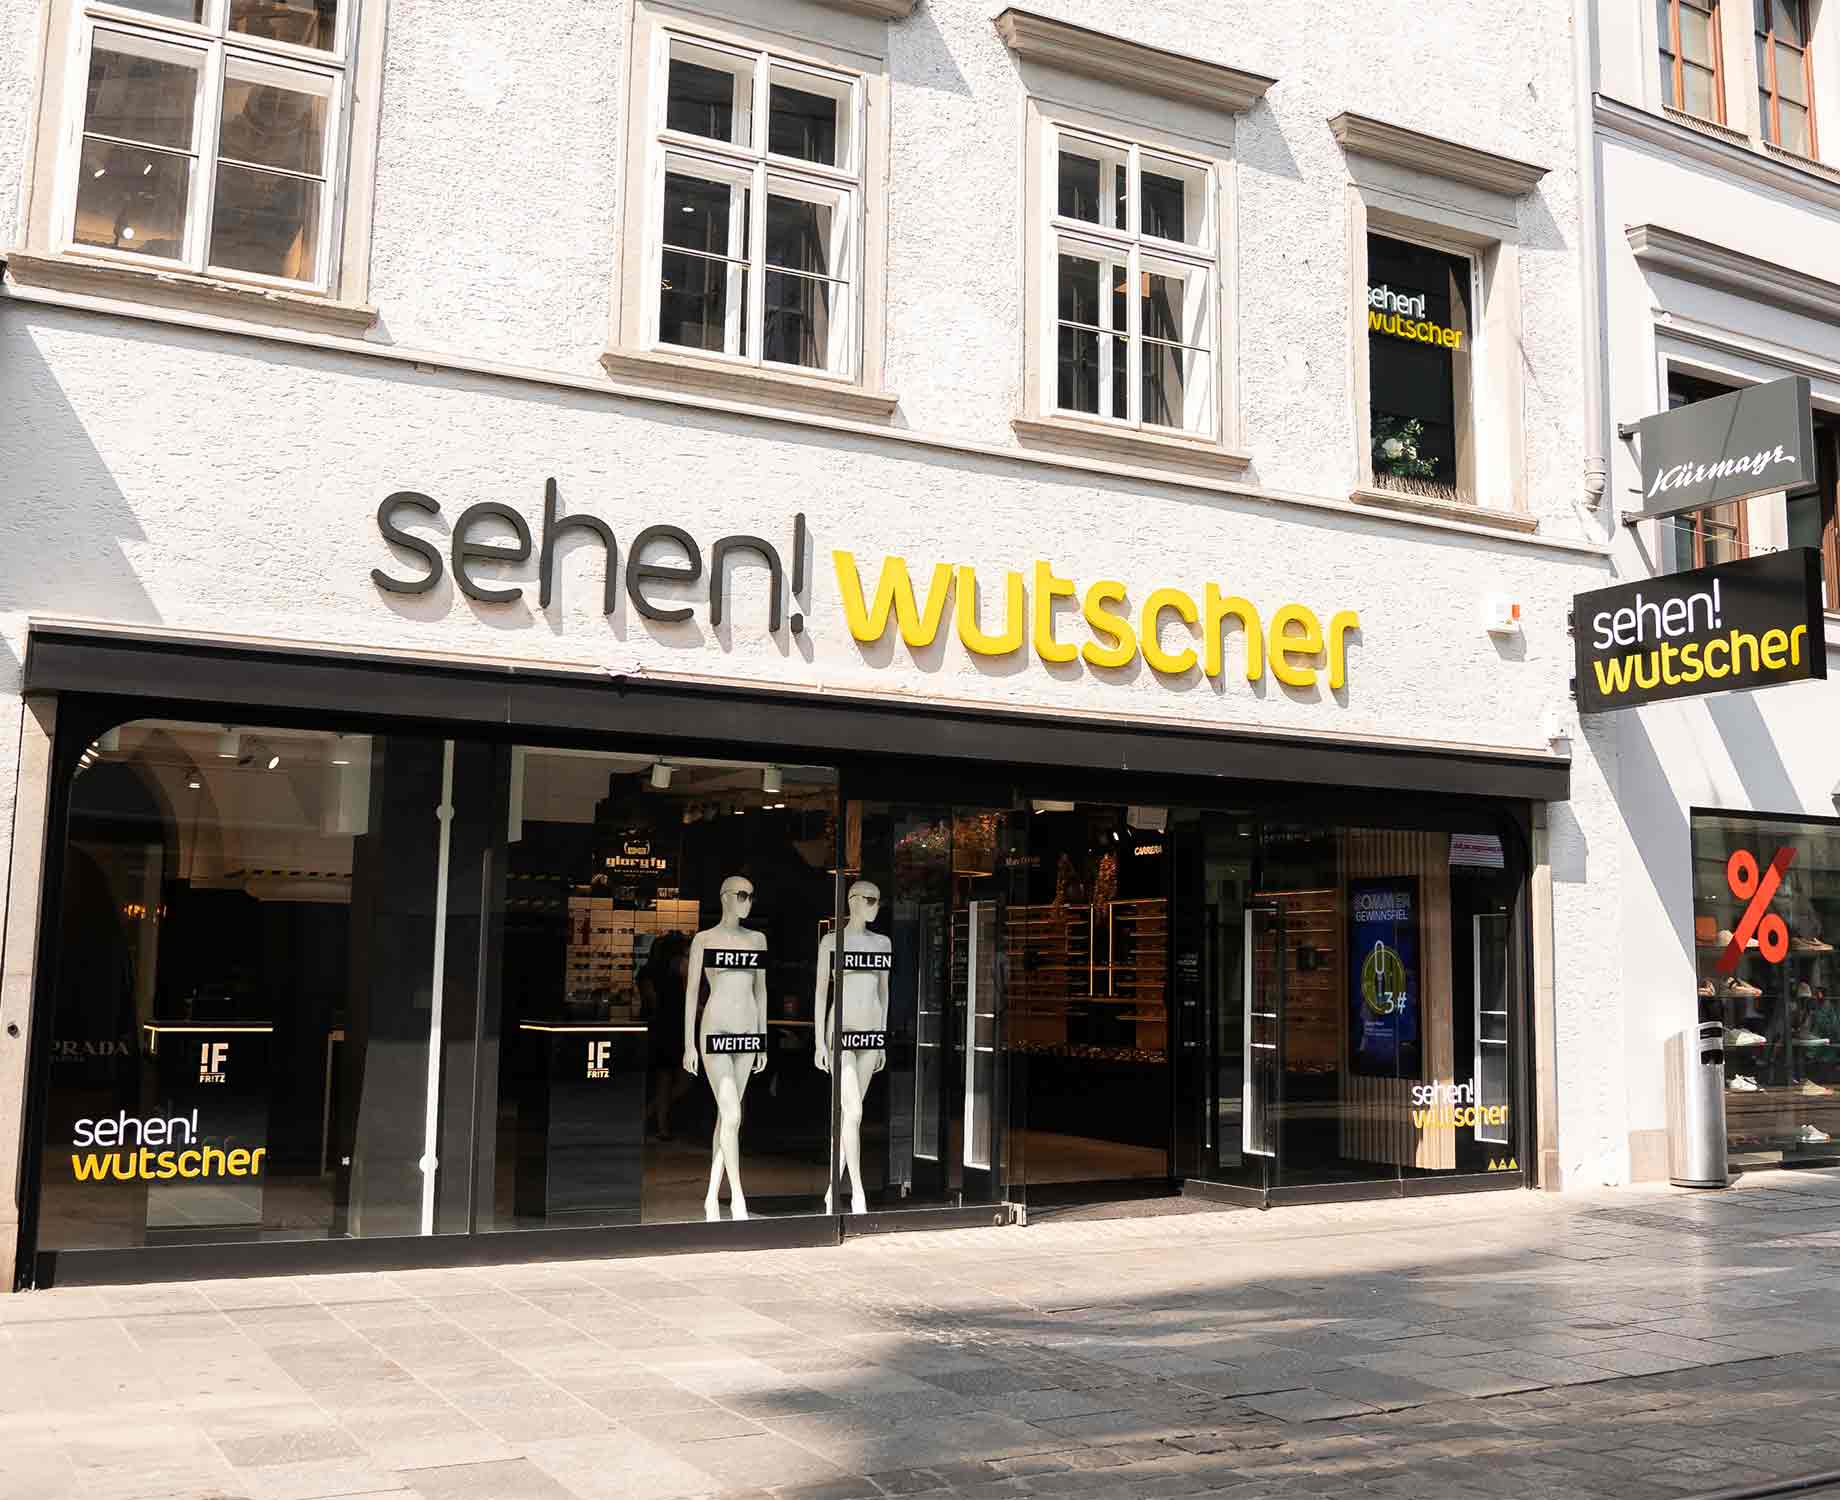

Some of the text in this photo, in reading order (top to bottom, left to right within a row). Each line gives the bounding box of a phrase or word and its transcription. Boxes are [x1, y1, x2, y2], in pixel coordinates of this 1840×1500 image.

[1647, 445, 1796, 498] Kürmayr
[370, 476, 1360, 690] sehen! wutscher
[1592, 578, 1722, 650] sehen!
[1593, 624, 1807, 695] wutscher
[844, 953, 892, 968] RILLEN
[712, 1037, 761, 1051] WEITER
[1412, 1078, 1474, 1106] sehen!
[72, 1108, 199, 1147] sehen!
[1412, 1104, 1508, 1129] wutscher
[71, 1146, 266, 1181] wutscher
